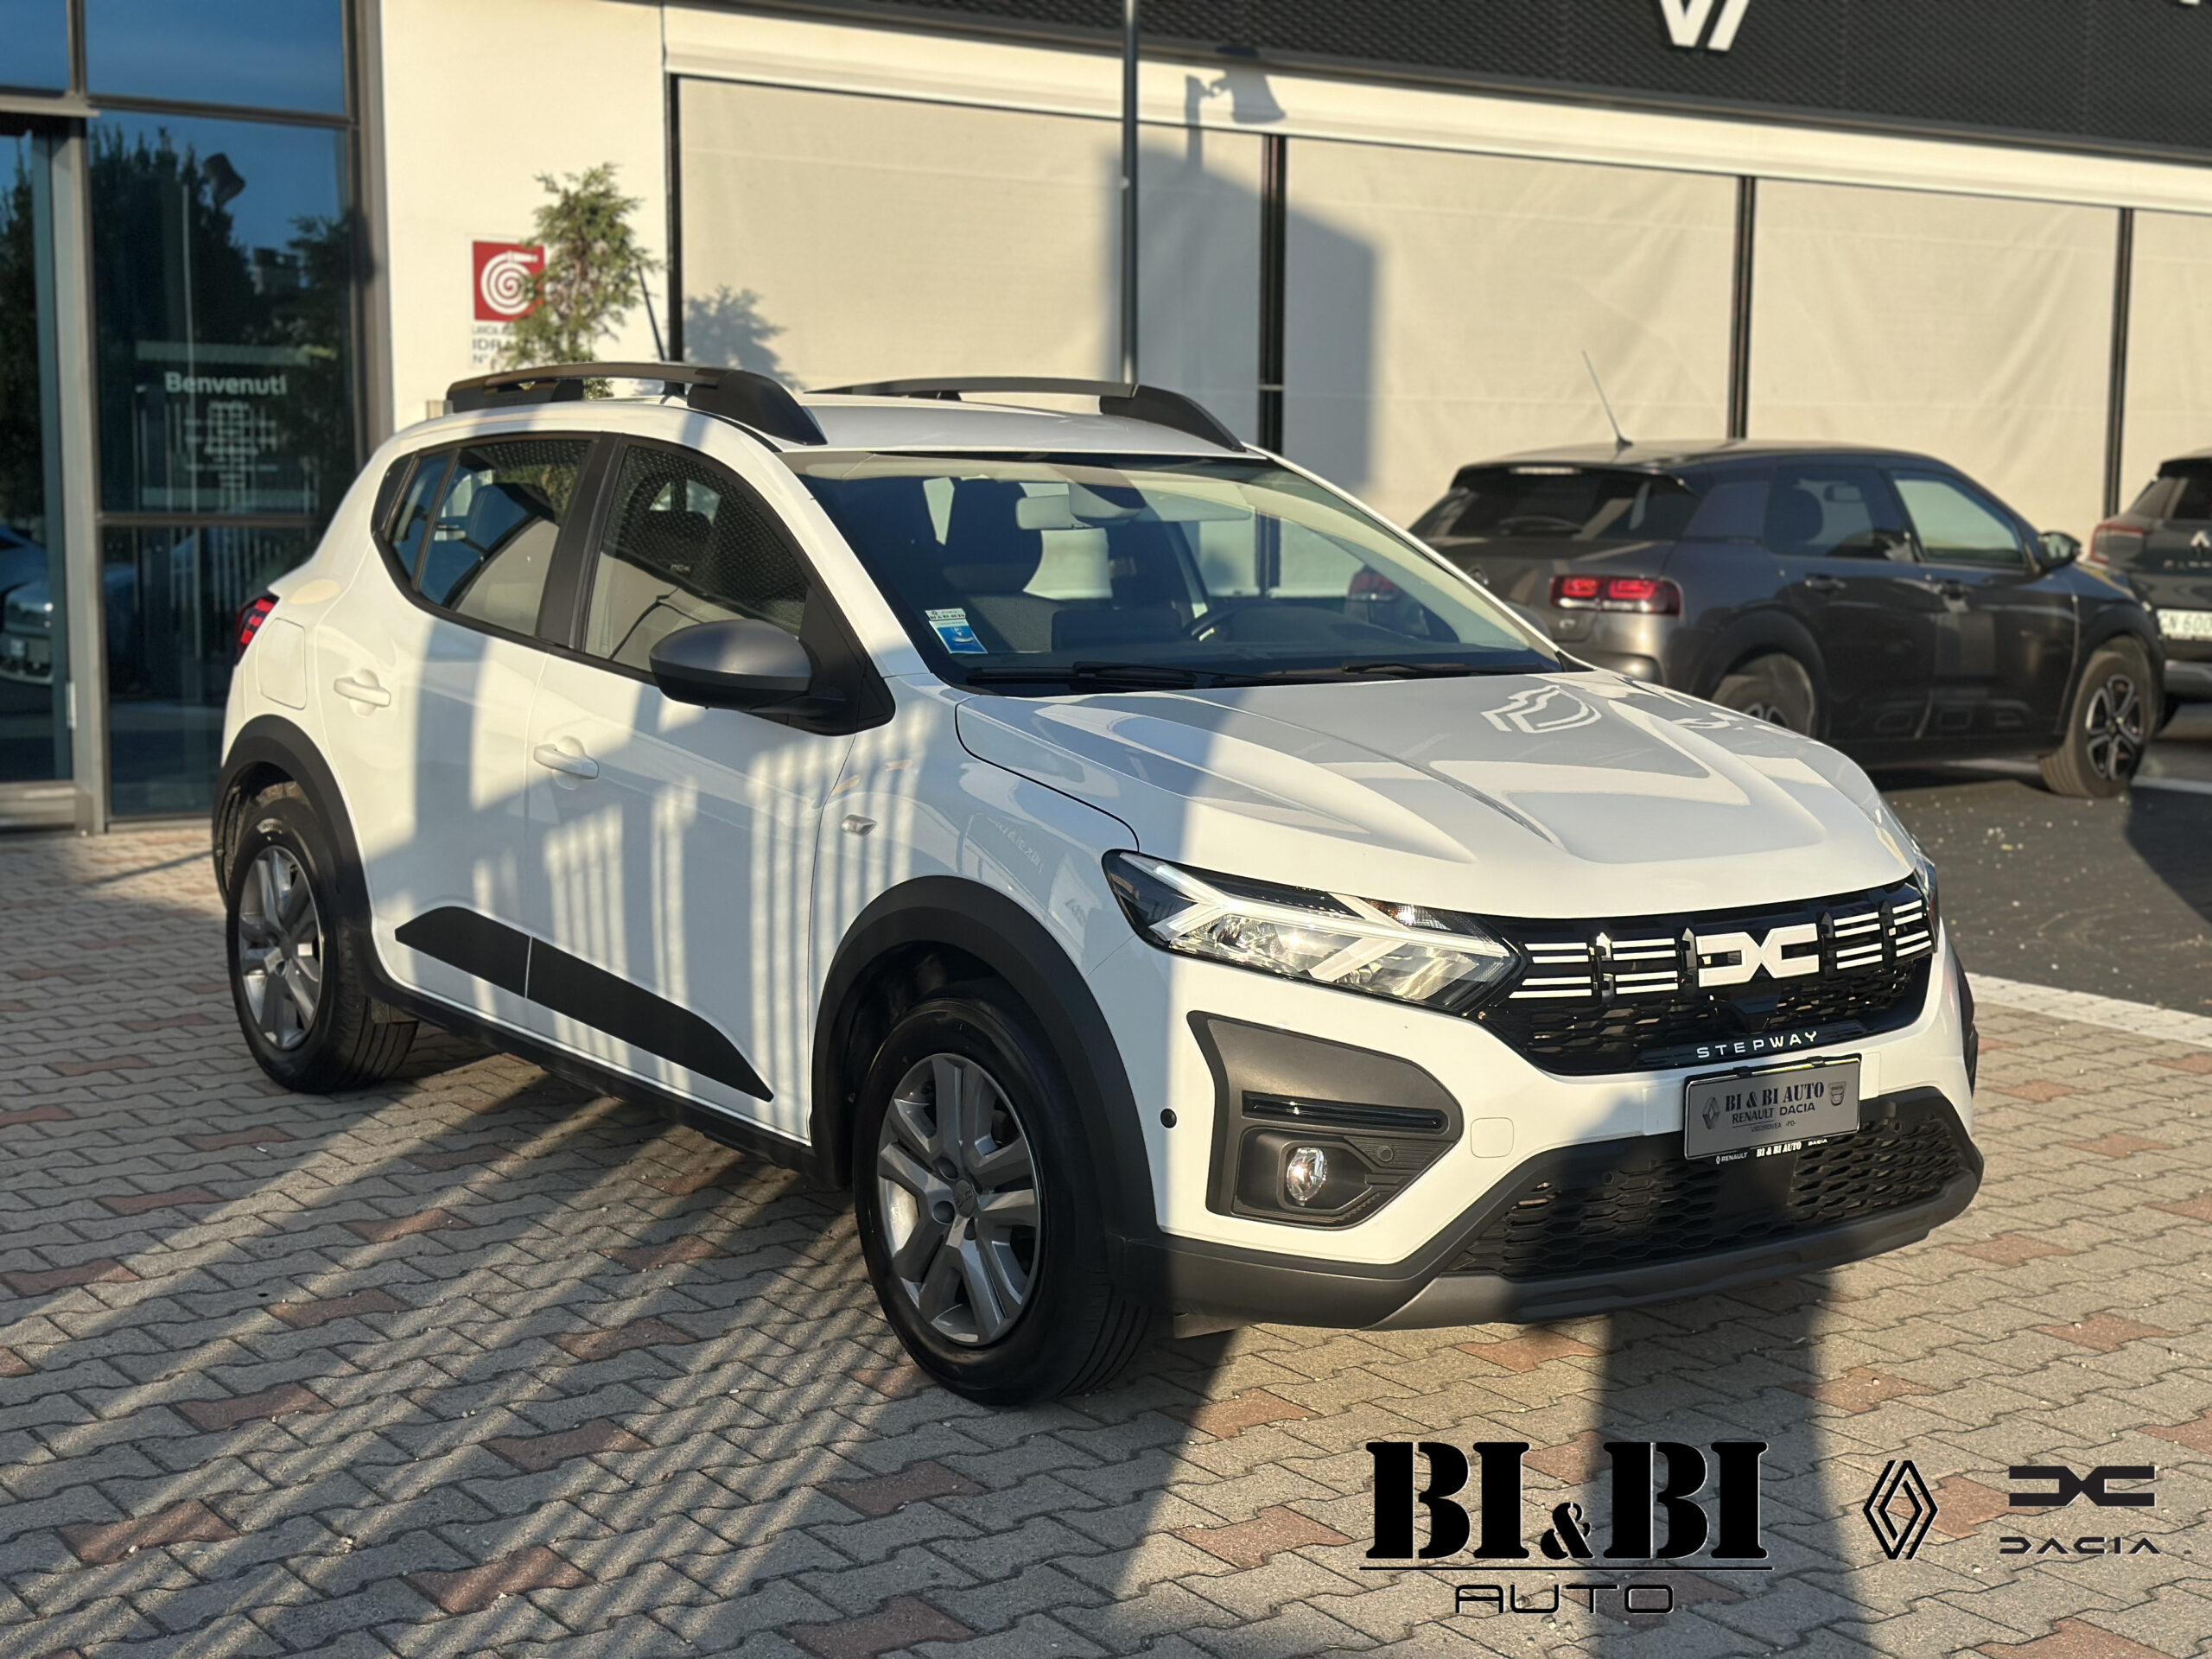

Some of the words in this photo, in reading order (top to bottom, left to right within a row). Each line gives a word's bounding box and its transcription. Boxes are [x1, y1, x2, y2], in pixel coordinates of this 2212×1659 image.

[1696, 1031, 1817, 1058] STEPWAY
[1725, 1093, 1742, 1112] BI
[1745, 1090, 1758, 1109] &
[1761, 1088, 1778, 1106] BI
[1782, 1081, 1825, 1103] AUTO
[1732, 1107, 1775, 1124] RENAULT
[1779, 1102, 1816, 1116] DACIA
[1720, 1151, 1749, 1163] RENAULT
[1782, 1140, 1802, 1154] AUTO
[1807, 1138, 1828, 1147] DACIA
